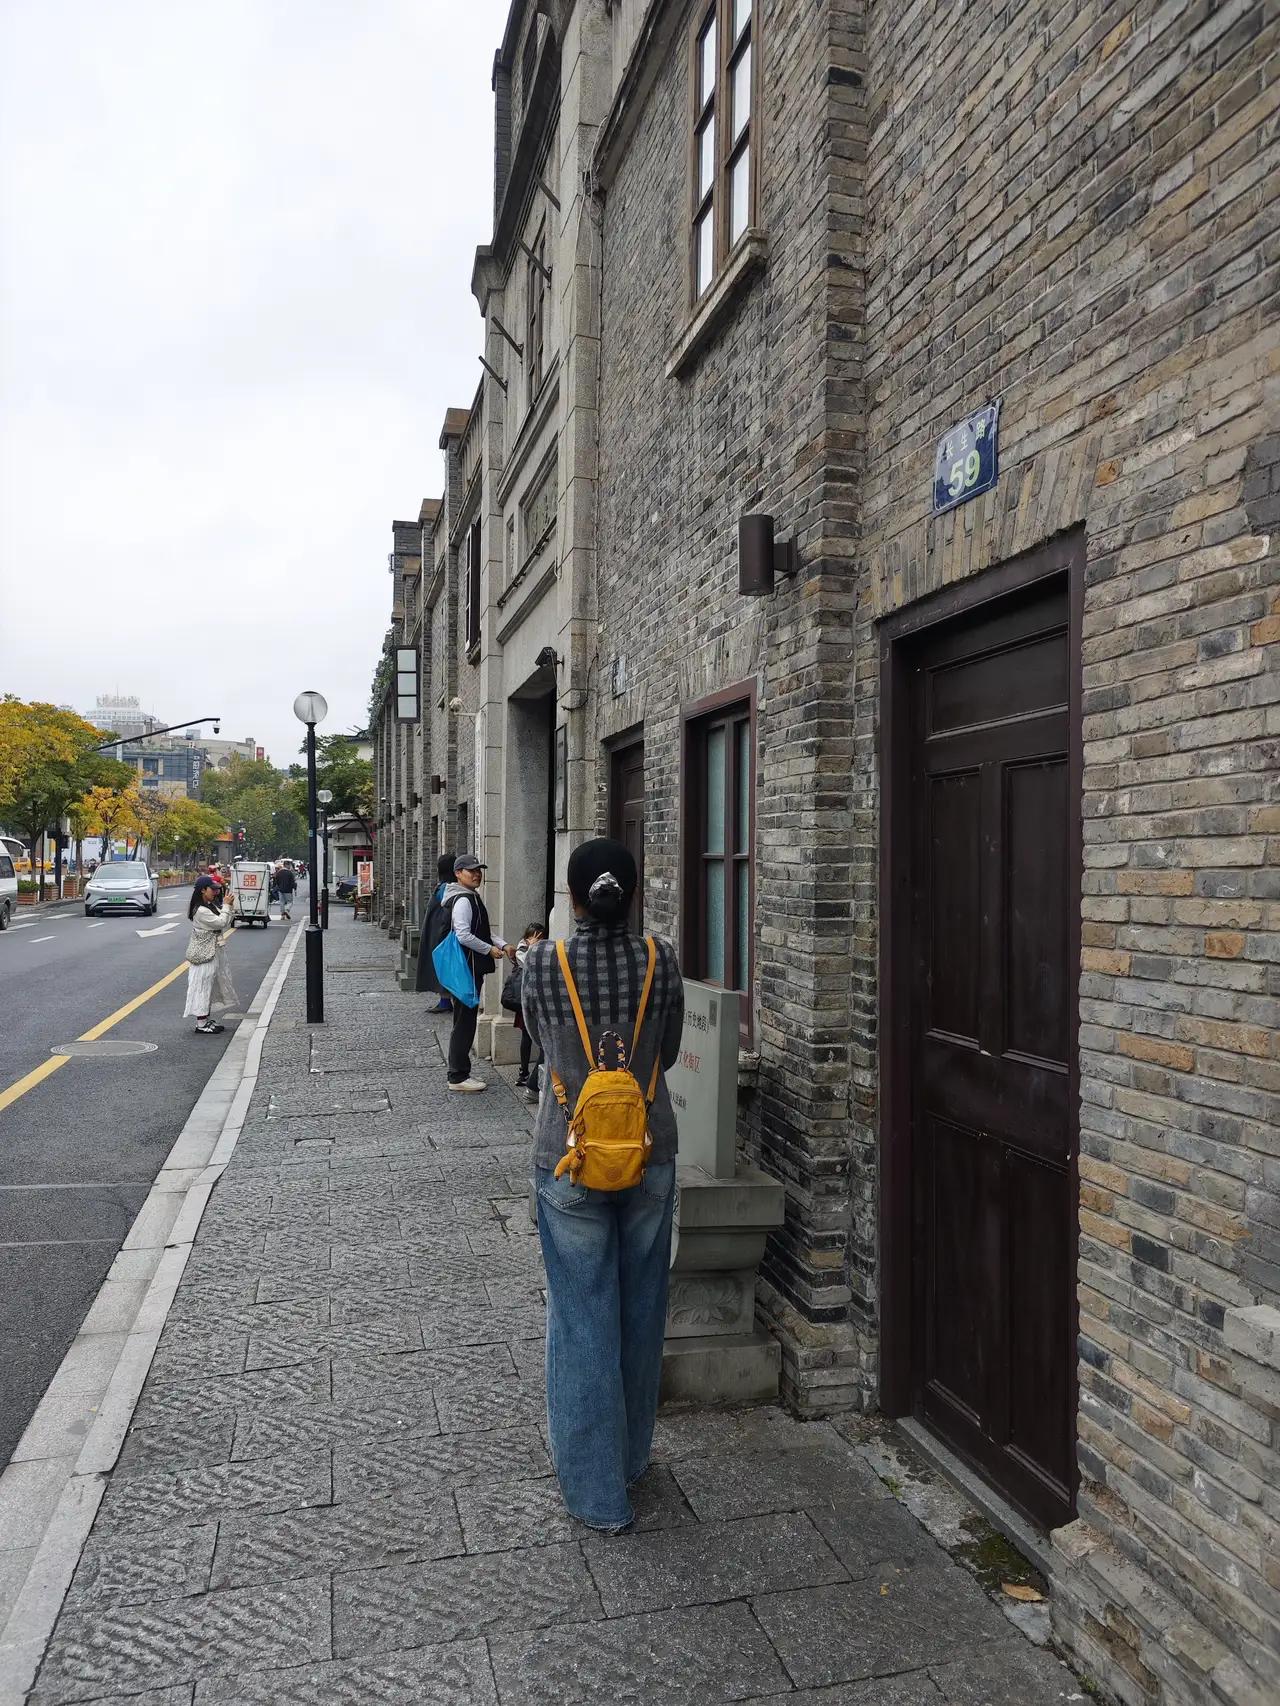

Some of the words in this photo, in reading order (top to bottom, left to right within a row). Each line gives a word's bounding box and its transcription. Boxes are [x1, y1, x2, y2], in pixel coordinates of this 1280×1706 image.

[945, 418, 986, 461] 长生路
[948, 449, 980, 497] 59
